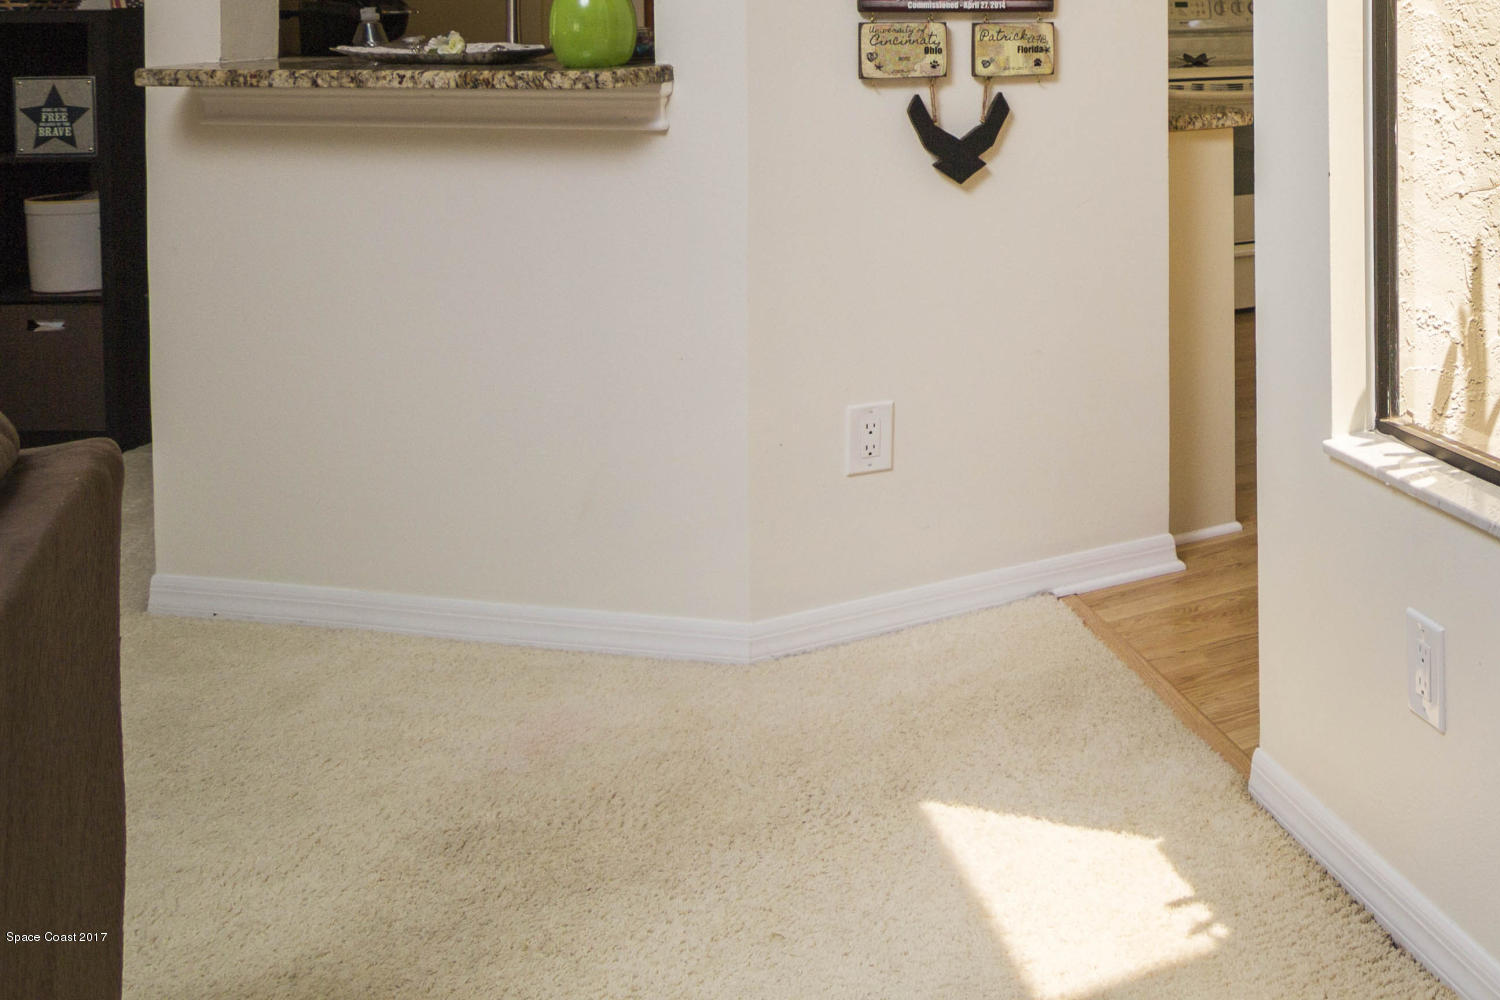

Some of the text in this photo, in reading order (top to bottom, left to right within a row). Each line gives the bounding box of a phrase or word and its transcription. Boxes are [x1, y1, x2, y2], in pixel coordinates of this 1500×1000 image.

[868, 25, 914, 37] University
[979, 28, 1027, 42] Patrick
[924, 46, 943, 55] Ohio
[1017, 45, 1044, 54] Florida
[41, 112, 69, 122] FREE
[38, 127, 73, 137] BRAVE
